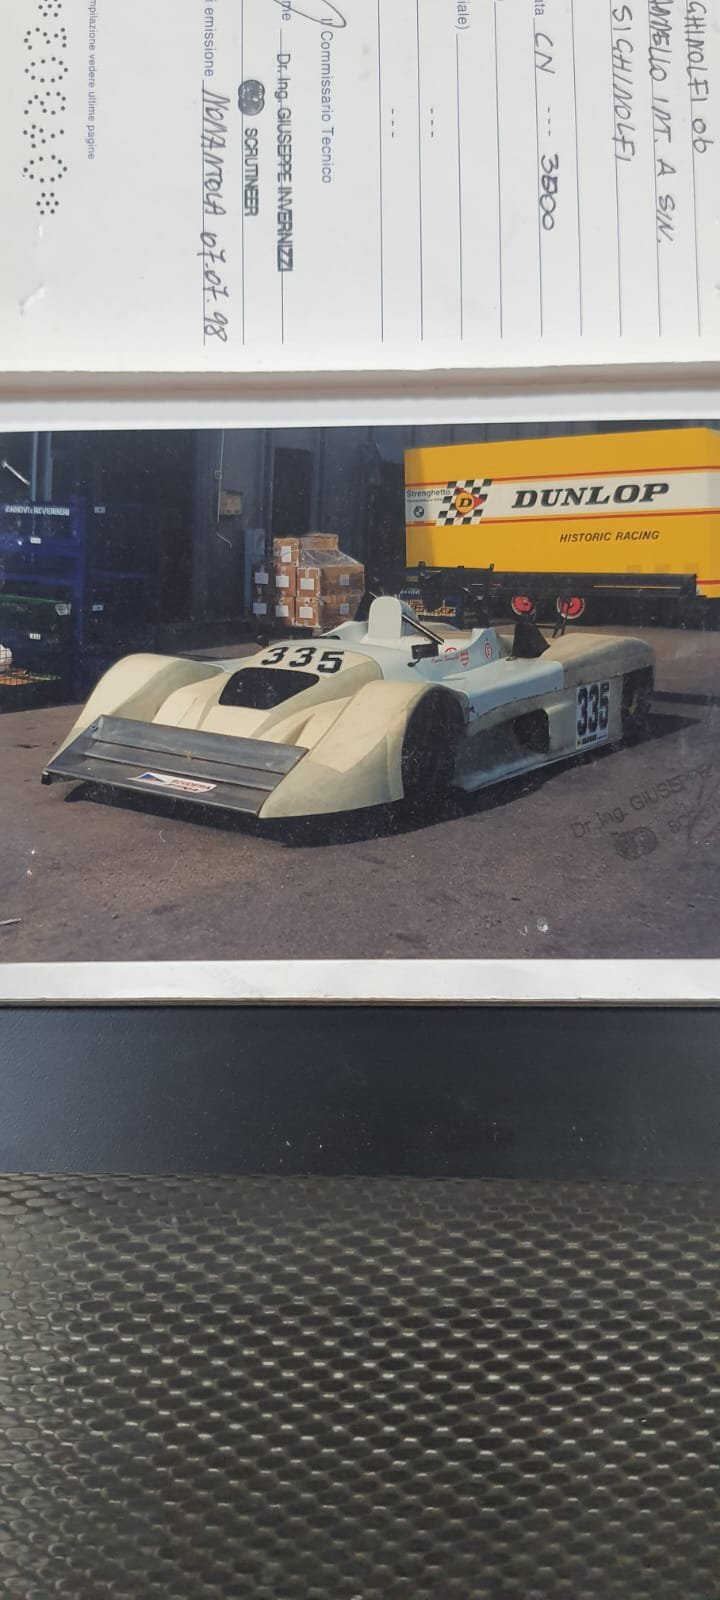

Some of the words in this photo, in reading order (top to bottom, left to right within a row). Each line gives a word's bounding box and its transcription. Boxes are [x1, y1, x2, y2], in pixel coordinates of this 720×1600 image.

[204, 7, 214, 77] emissione
[535, 33, 555, 75] CN
[87, 54, 96, 88] vedere
[276, 53, 291, 73] Dr.
[320, 30, 334, 122] Commissario
[87, 91, 96, 121] ultime
[274, 77, 290, 104] Ing.
[85, 125, 96, 160] pagine
[276, 107, 292, 183] GIUSEPPE
[321, 127, 335, 184] Tecnico
[244, 127, 259, 217] SCRUTINEER
[657, 157, 676, 177] A
[277, 186, 294, 272] INVERNIZZI
[459, 497, 472, 508] D
[511, 482, 669, 509] DUNLOP
[559, 531, 612, 543] HISTORIC
[615, 530, 660, 542] RACING
[261, 645, 345, 674] 335
[576, 681, 611, 737] 335
